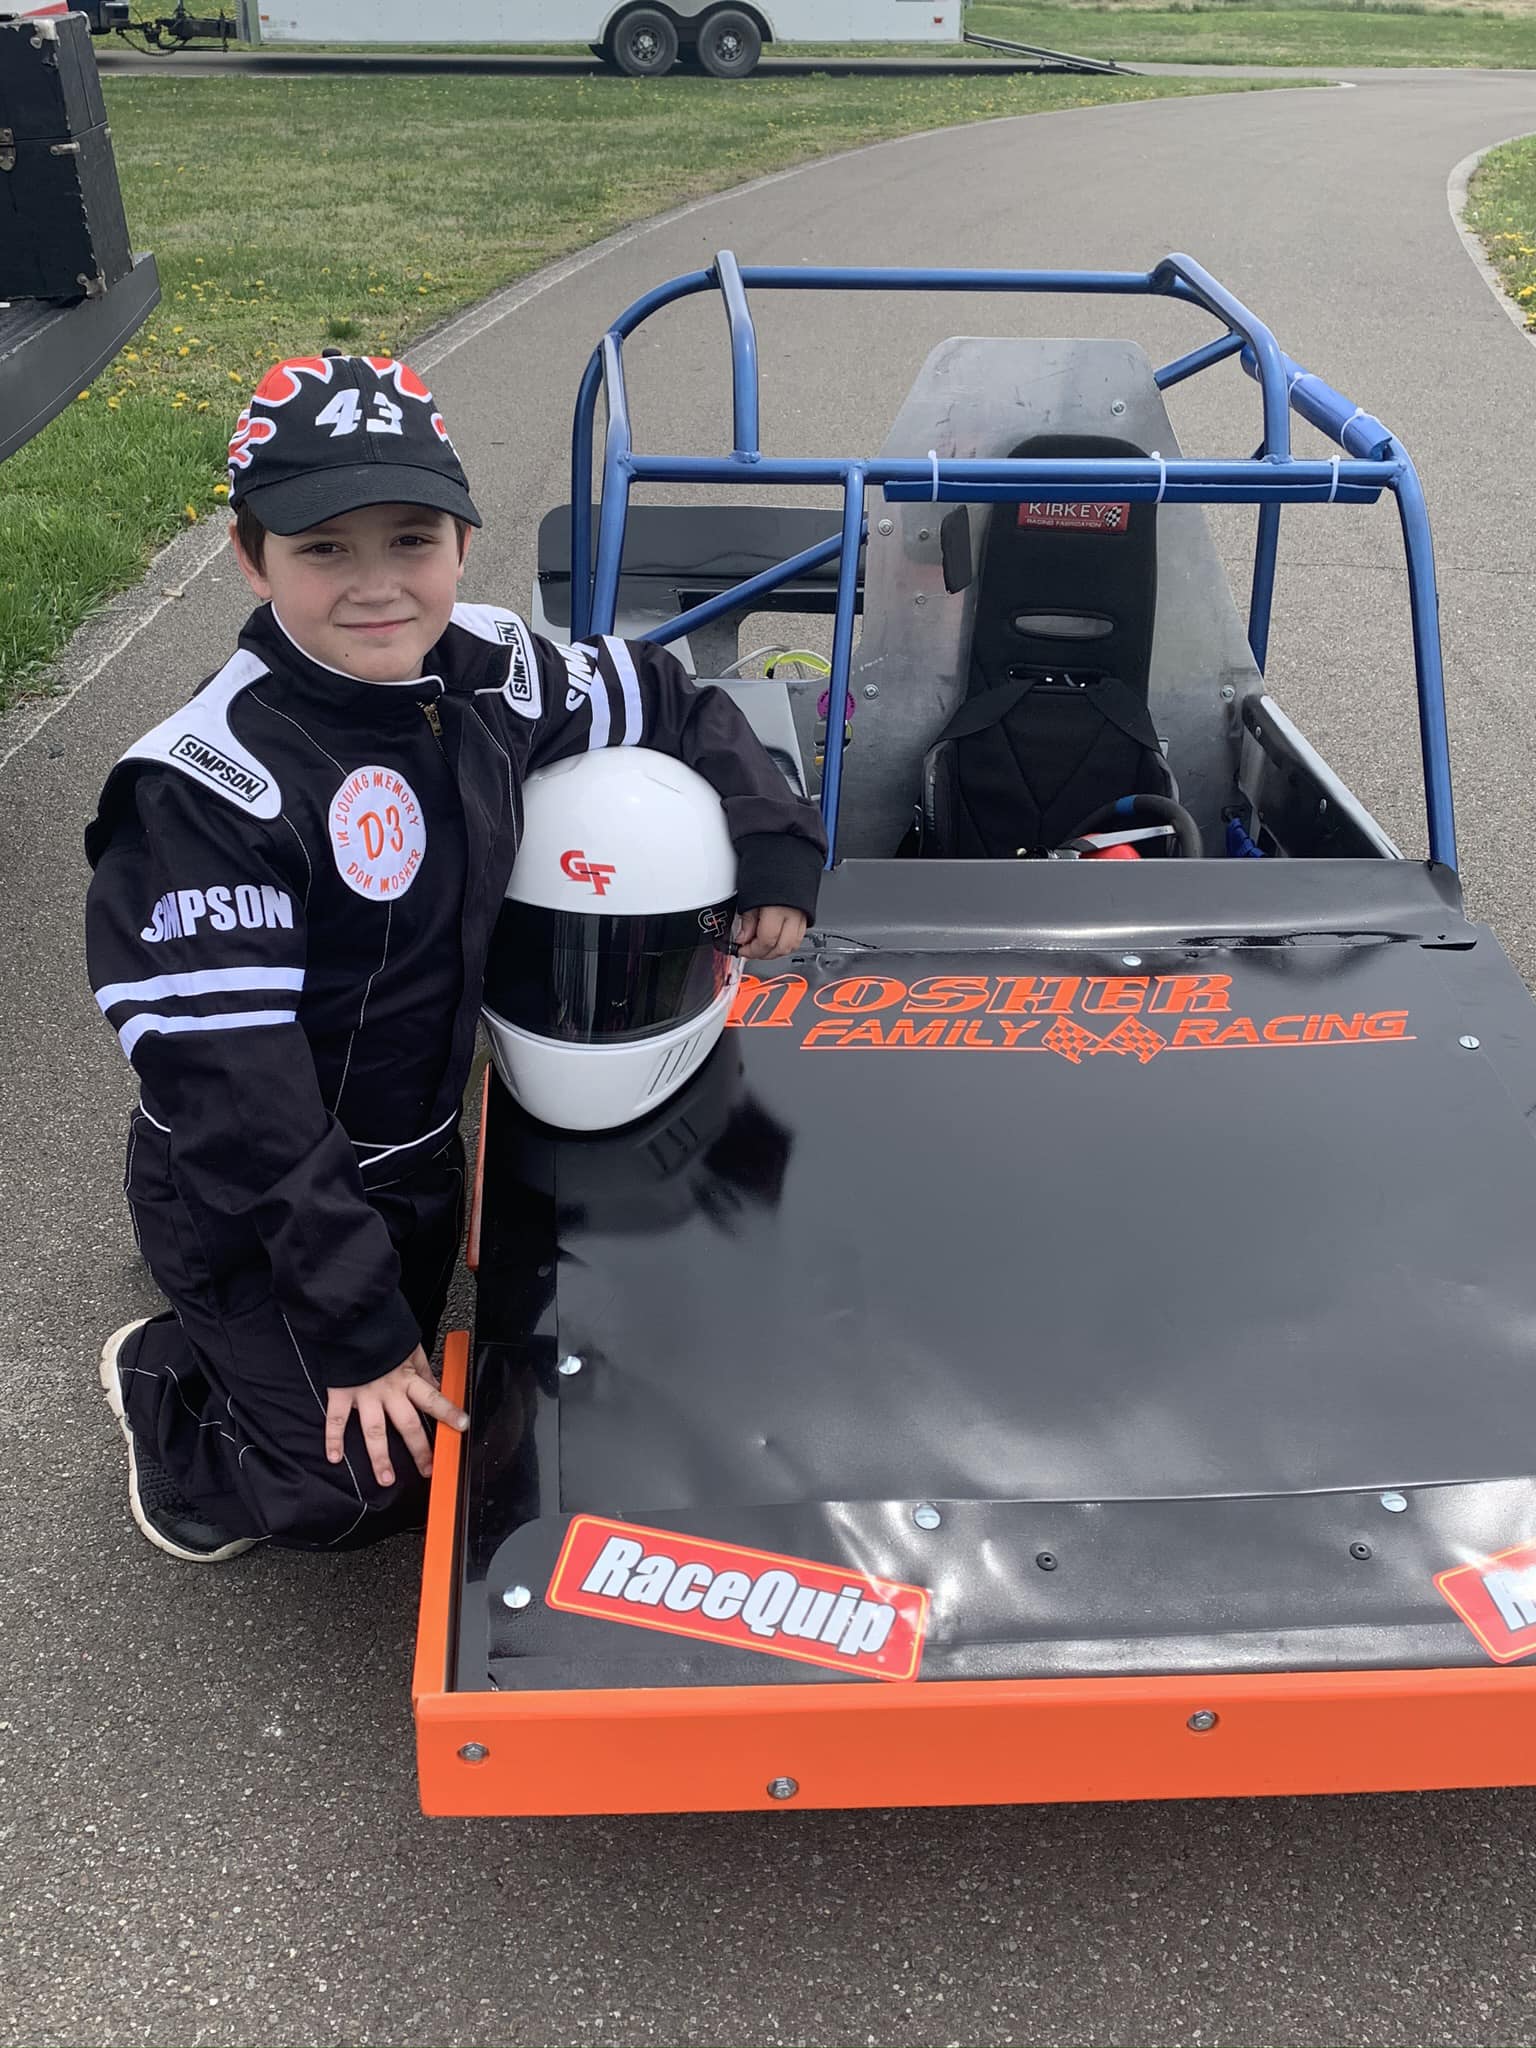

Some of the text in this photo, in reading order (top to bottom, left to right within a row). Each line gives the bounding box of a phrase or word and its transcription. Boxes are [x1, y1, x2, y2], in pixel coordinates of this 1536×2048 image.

[315, 388, 403, 437] 43
[1028, 502, 1106, 519] KIRKEY
[179, 741, 260, 795] SIMPSON
[373, 771, 419, 826] MEMORY
[357, 805, 404, 861] D3
[346, 848, 422, 893] DON MOSHER
[560, 850, 617, 896] GF
[140, 884, 295, 943] SIMPSON
[802, 1010, 1409, 1047] FAMILY RACING
[580, 1535, 897, 1656] RaceQuip
